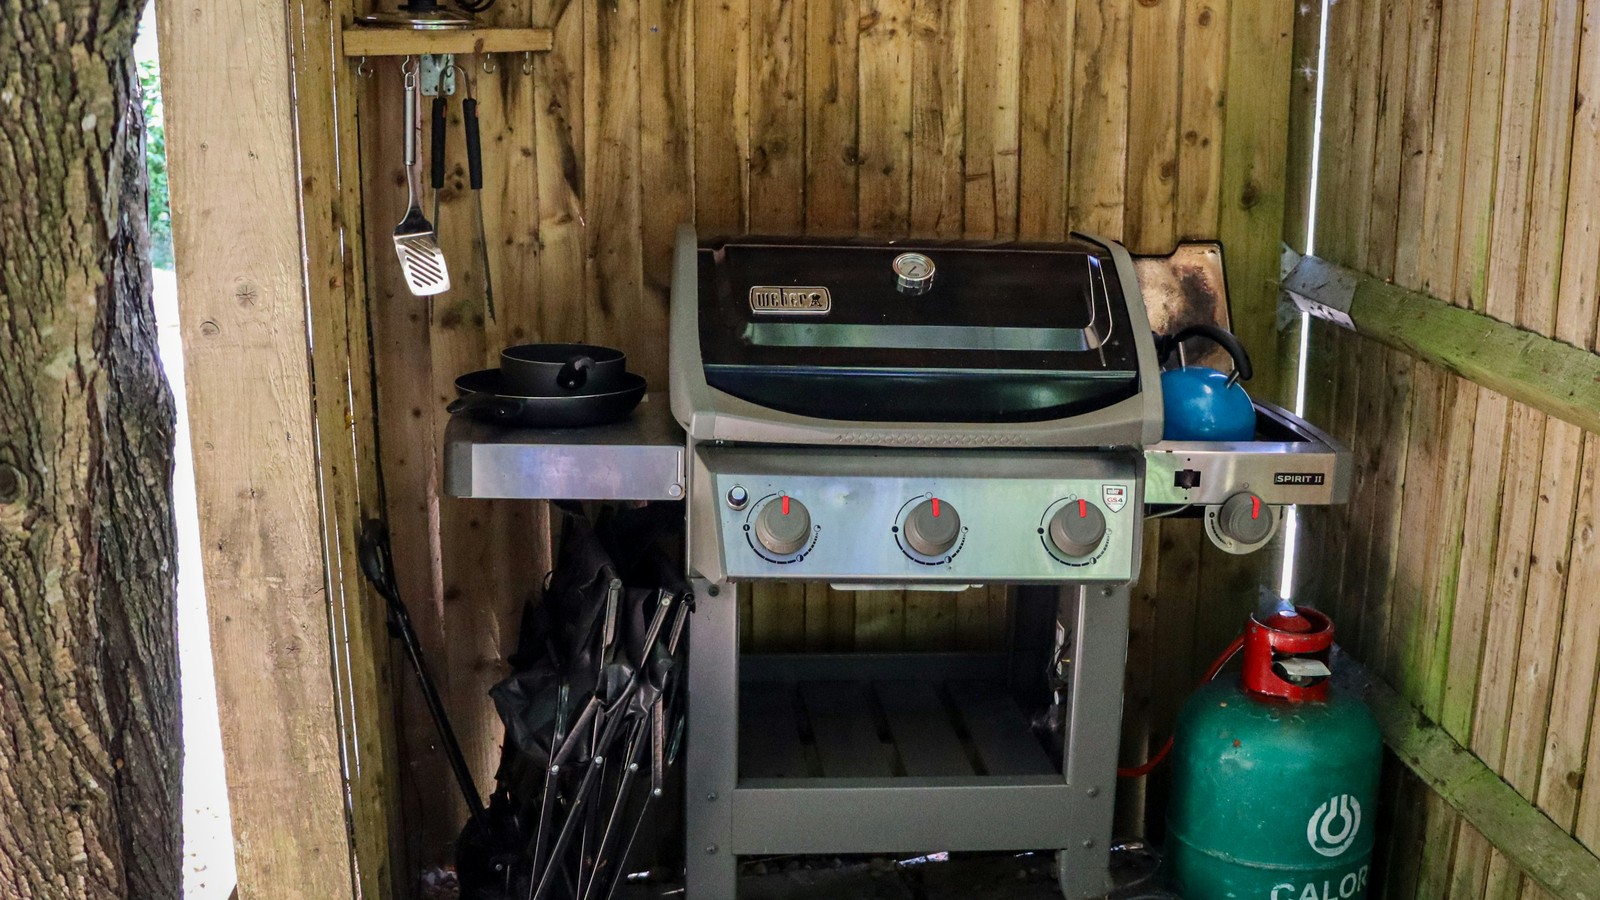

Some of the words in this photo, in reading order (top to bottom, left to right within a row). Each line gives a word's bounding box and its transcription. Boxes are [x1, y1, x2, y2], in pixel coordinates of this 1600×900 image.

[1277, 475, 1312, 483] SPIRIT
[1314, 475, 1322, 483] II
[1270, 865, 1368, 900] CALOR
